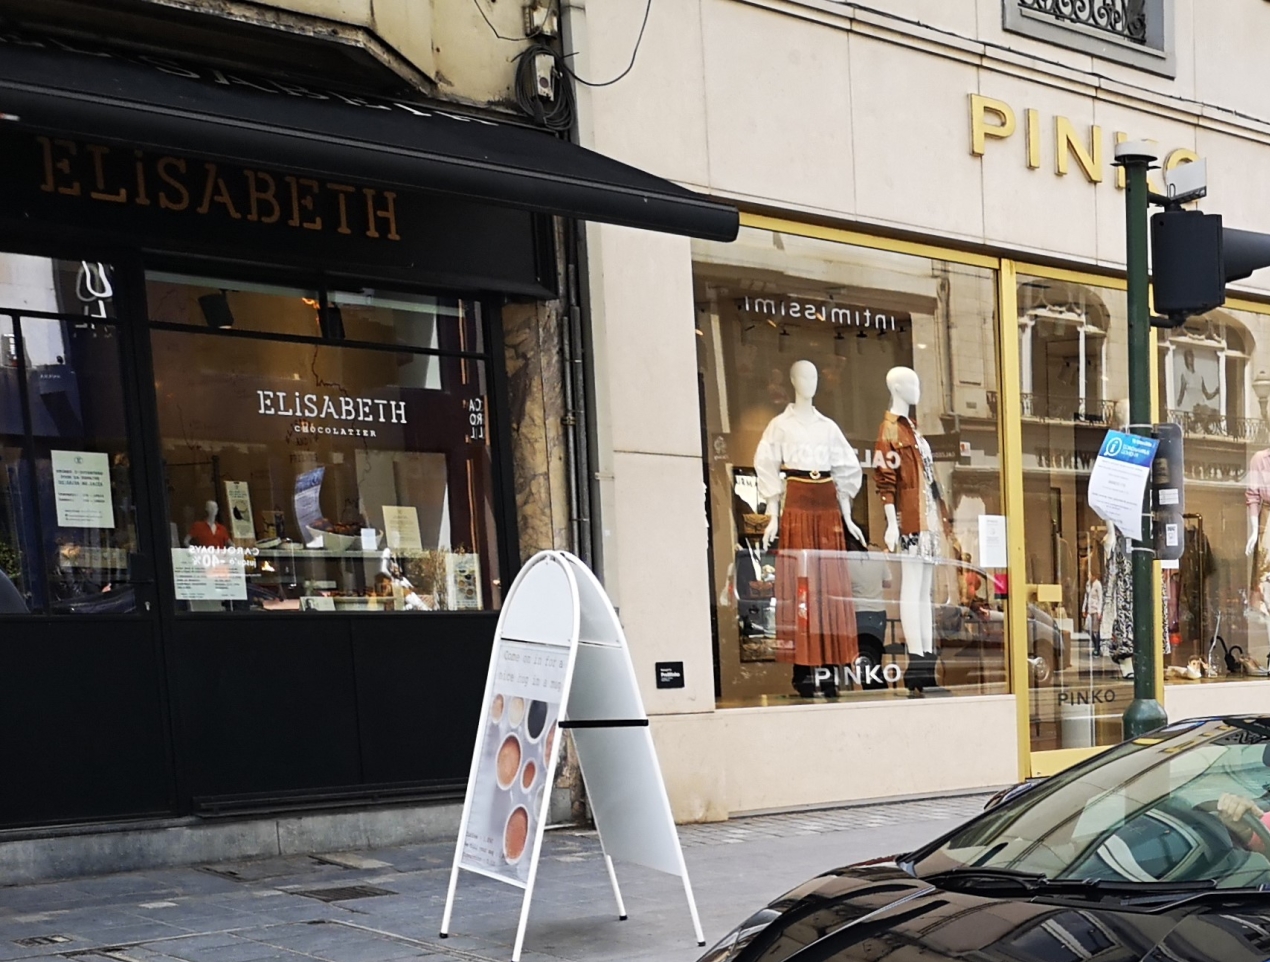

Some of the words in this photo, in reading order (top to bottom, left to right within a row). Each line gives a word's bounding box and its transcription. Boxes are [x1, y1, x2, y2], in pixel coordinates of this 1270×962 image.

[293, 423, 378, 438] CHOCOLATIER
[814, 663, 902, 687] PINKO
[1057, 688, 1116, 707] PINKO
